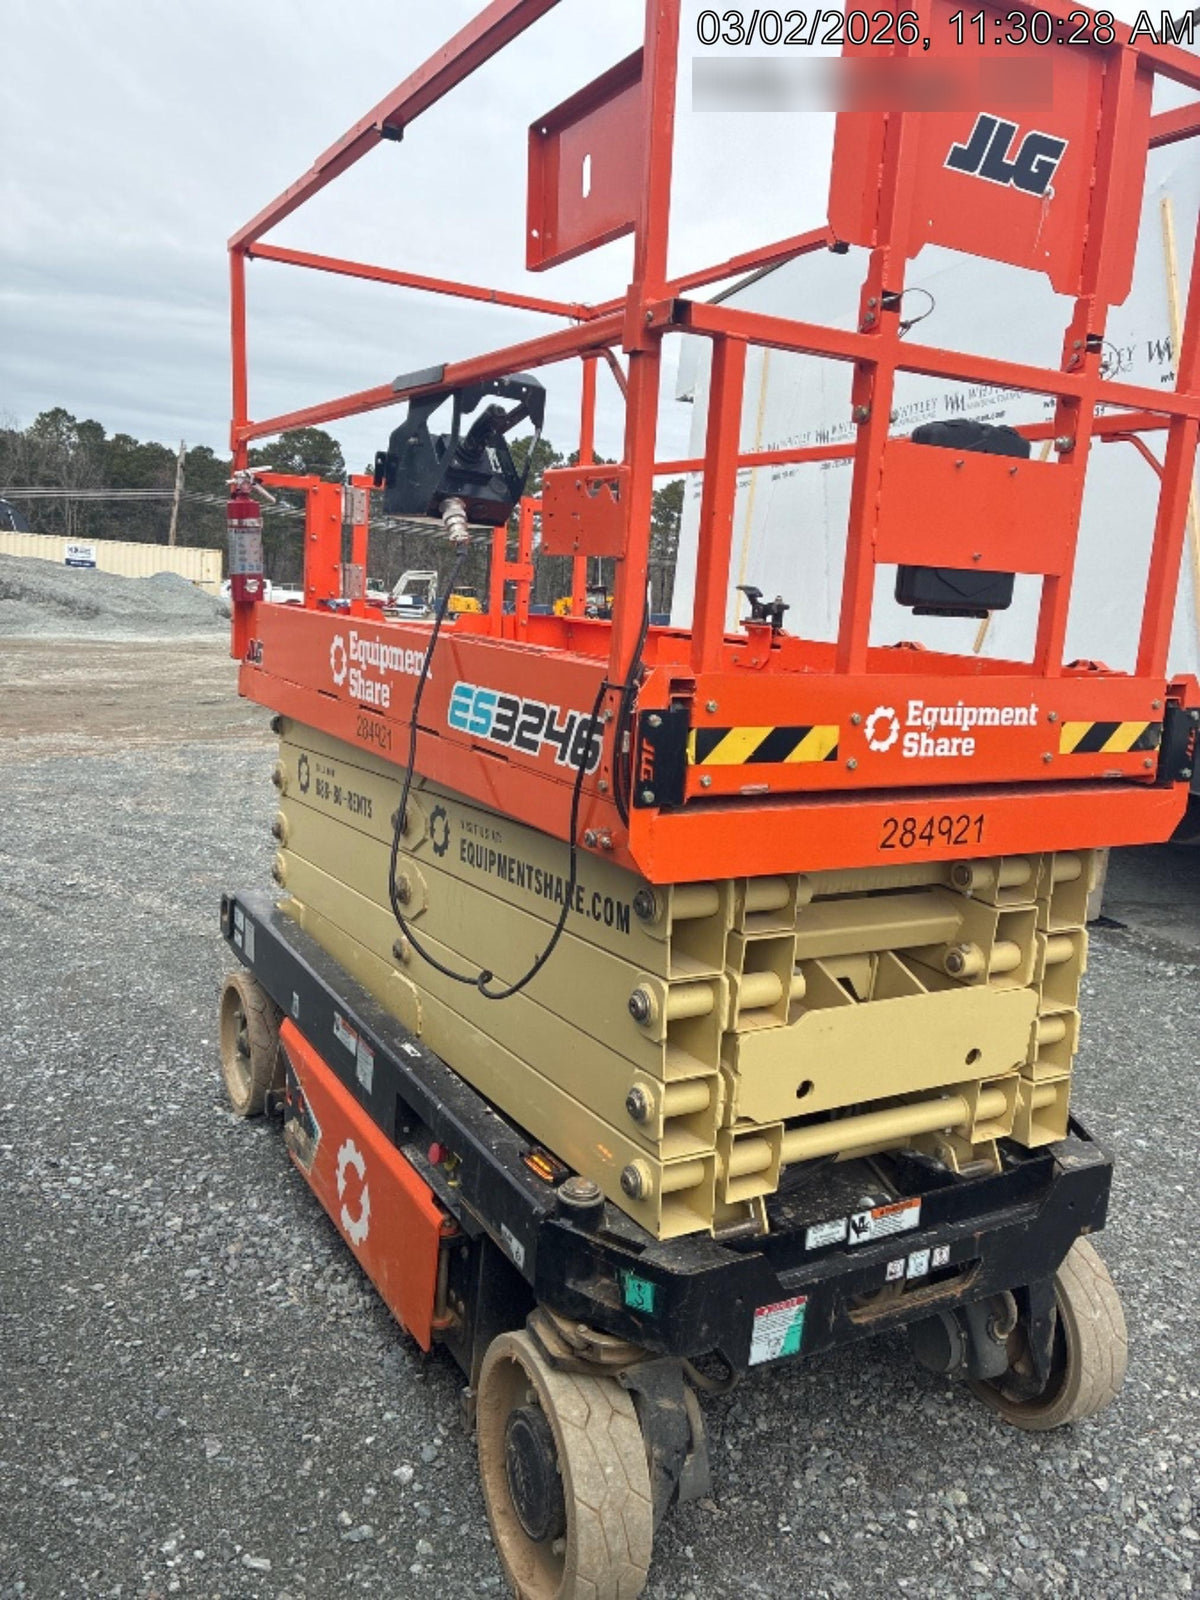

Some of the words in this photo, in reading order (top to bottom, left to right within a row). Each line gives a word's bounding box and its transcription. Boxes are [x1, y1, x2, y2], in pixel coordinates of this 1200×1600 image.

[943, 112, 1068, 198] JLG
[349, 667, 391, 708] Share
[356, 714, 392, 751] 284921
[448, 680, 605, 775] ES3246
[905, 700, 1038, 731] Equipment
[902, 731, 975, 758] Share
[880, 814, 985, 849] 284921
